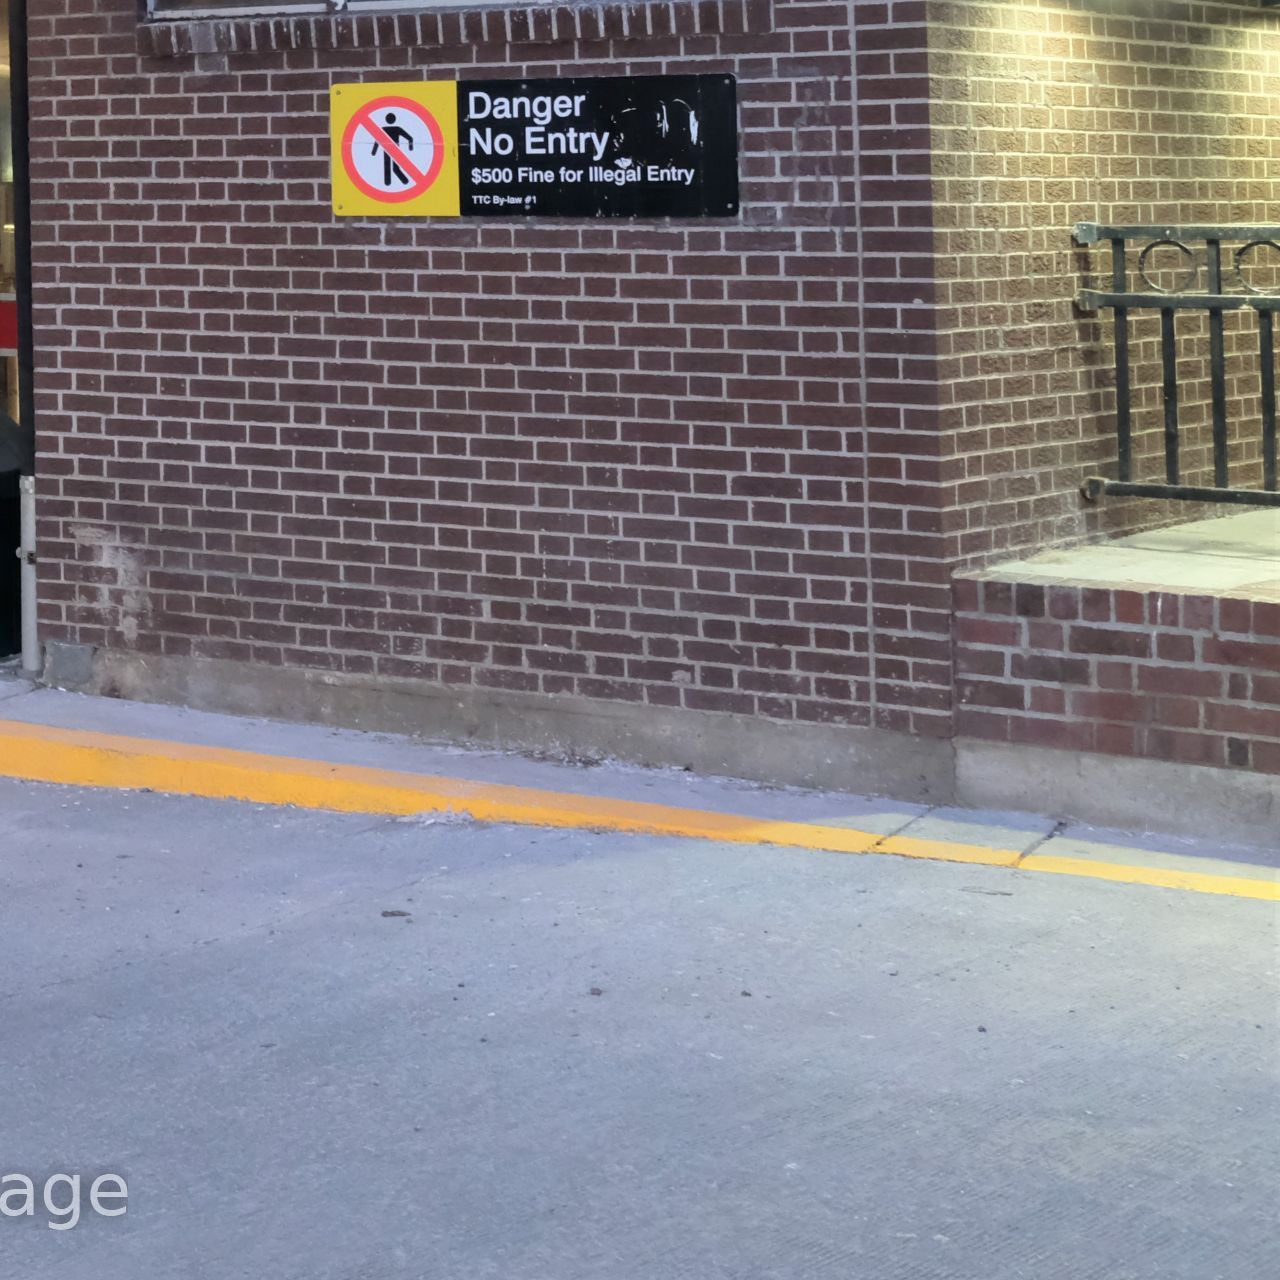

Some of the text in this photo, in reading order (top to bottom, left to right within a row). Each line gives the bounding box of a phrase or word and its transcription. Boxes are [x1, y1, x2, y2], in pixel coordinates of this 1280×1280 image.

[468, 91, 586, 125] Danger
[469, 126, 610, 161] No Entry
[471, 165, 695, 186] $500 Fine for Illegal Entry
[472, 195, 537, 206] TTC By-law #1
